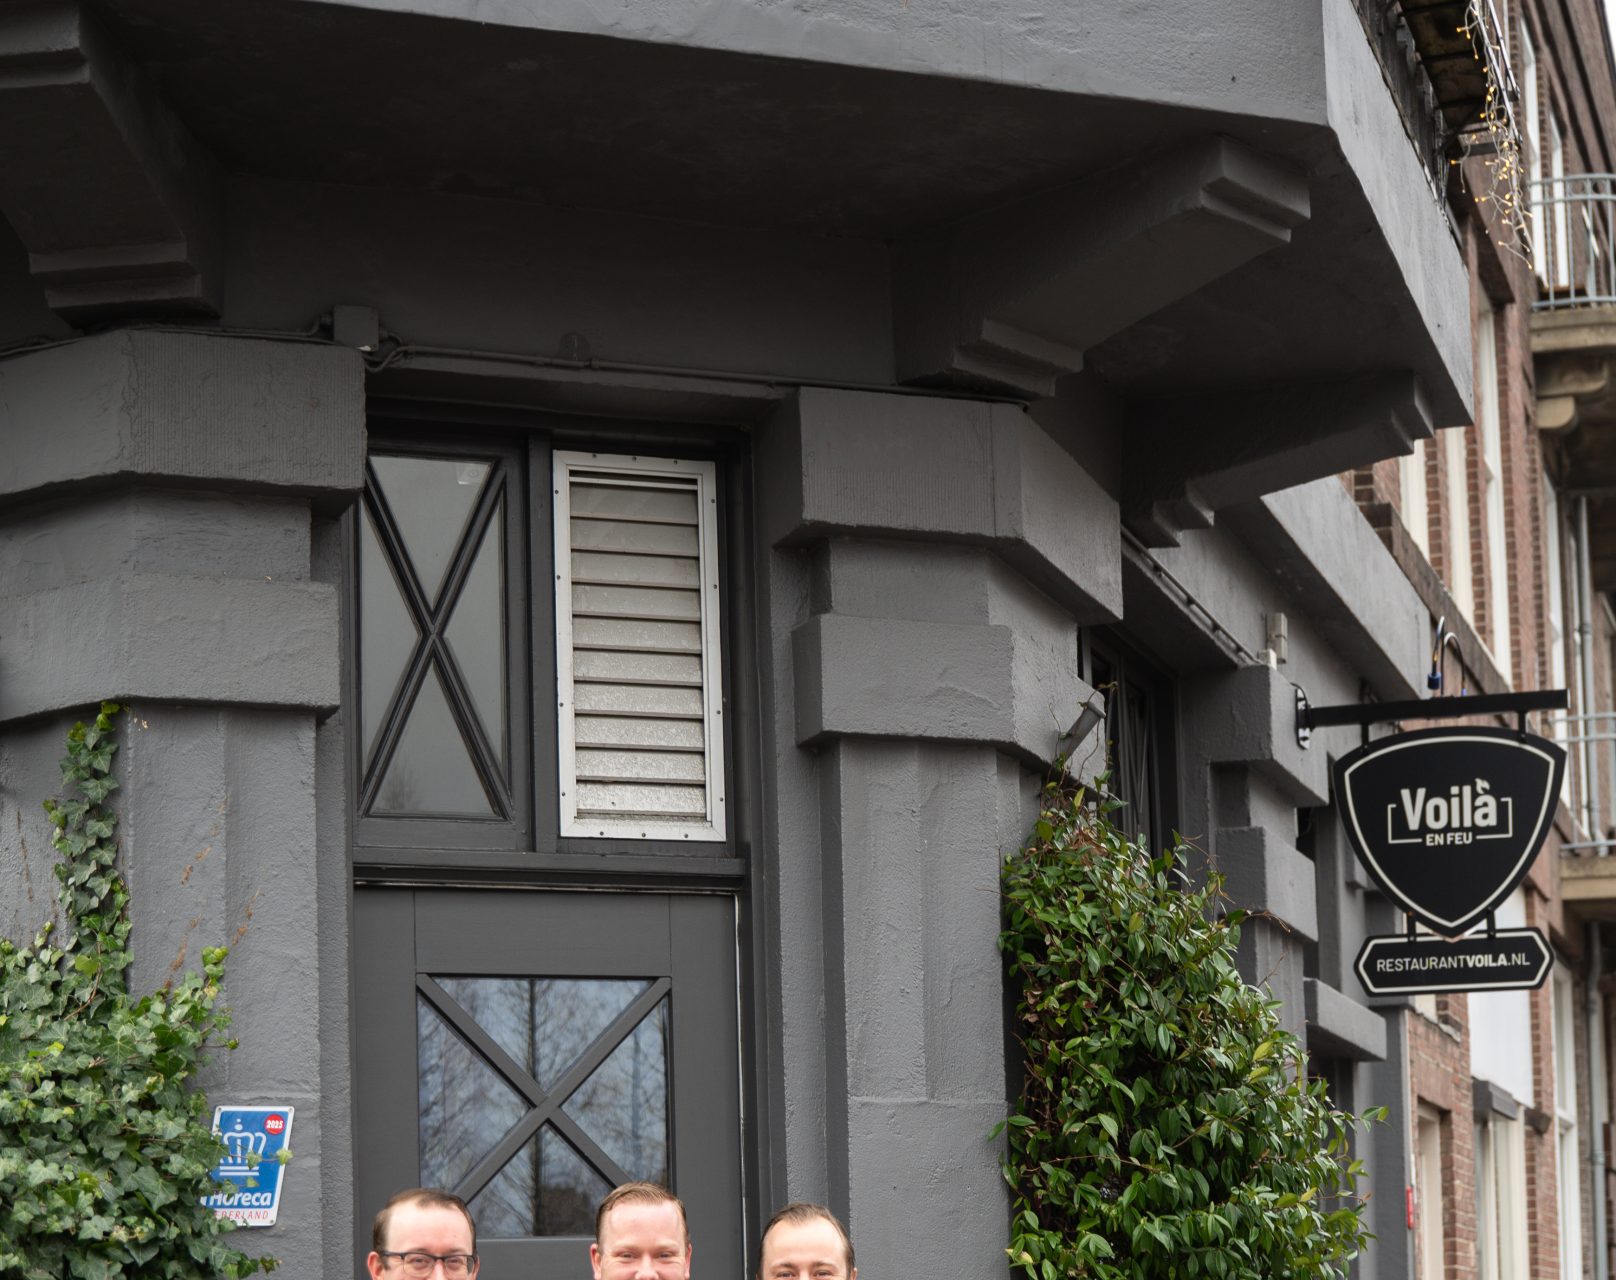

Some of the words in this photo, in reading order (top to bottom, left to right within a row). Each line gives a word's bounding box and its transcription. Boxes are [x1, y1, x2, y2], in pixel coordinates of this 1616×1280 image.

[1400, 778, 1497, 830] Voilà
[1426, 833, 1444, 846] EN
[1446, 832, 1472, 845] FEU
[1376, 952, 1531, 972] RESTAURANTVOILA.NL
[266, 1119, 284, 1129] 2025
[214, 1210, 269, 1220] EDERLAND
